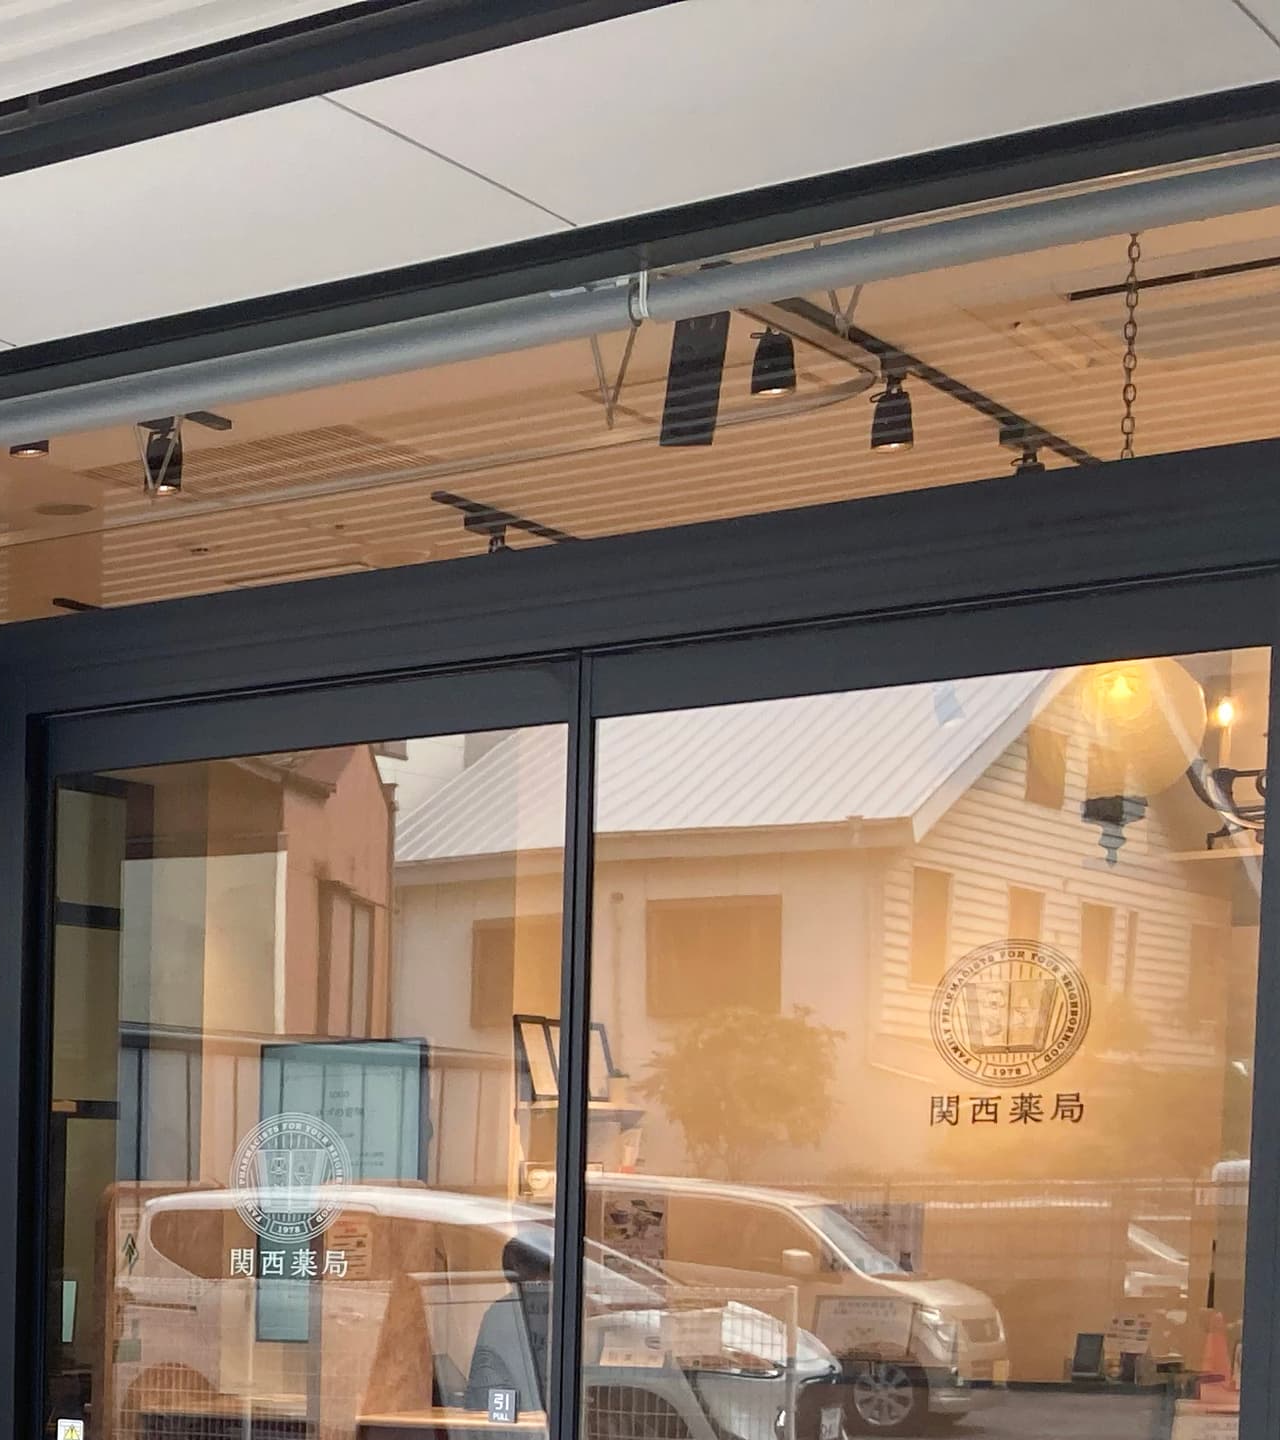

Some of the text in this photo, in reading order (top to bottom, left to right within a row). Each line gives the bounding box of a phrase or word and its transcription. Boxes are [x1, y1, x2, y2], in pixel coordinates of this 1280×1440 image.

[992, 1068, 1022, 1077] 1978
[930, 1092, 1084, 1127] 関西薬局
[278, 1225, 300, 1234] 1978
[230, 1248, 348, 1278] 関西薬局
[494, 1393, 510, 1411] 引
[493, 1412, 509, 1421] PULL
